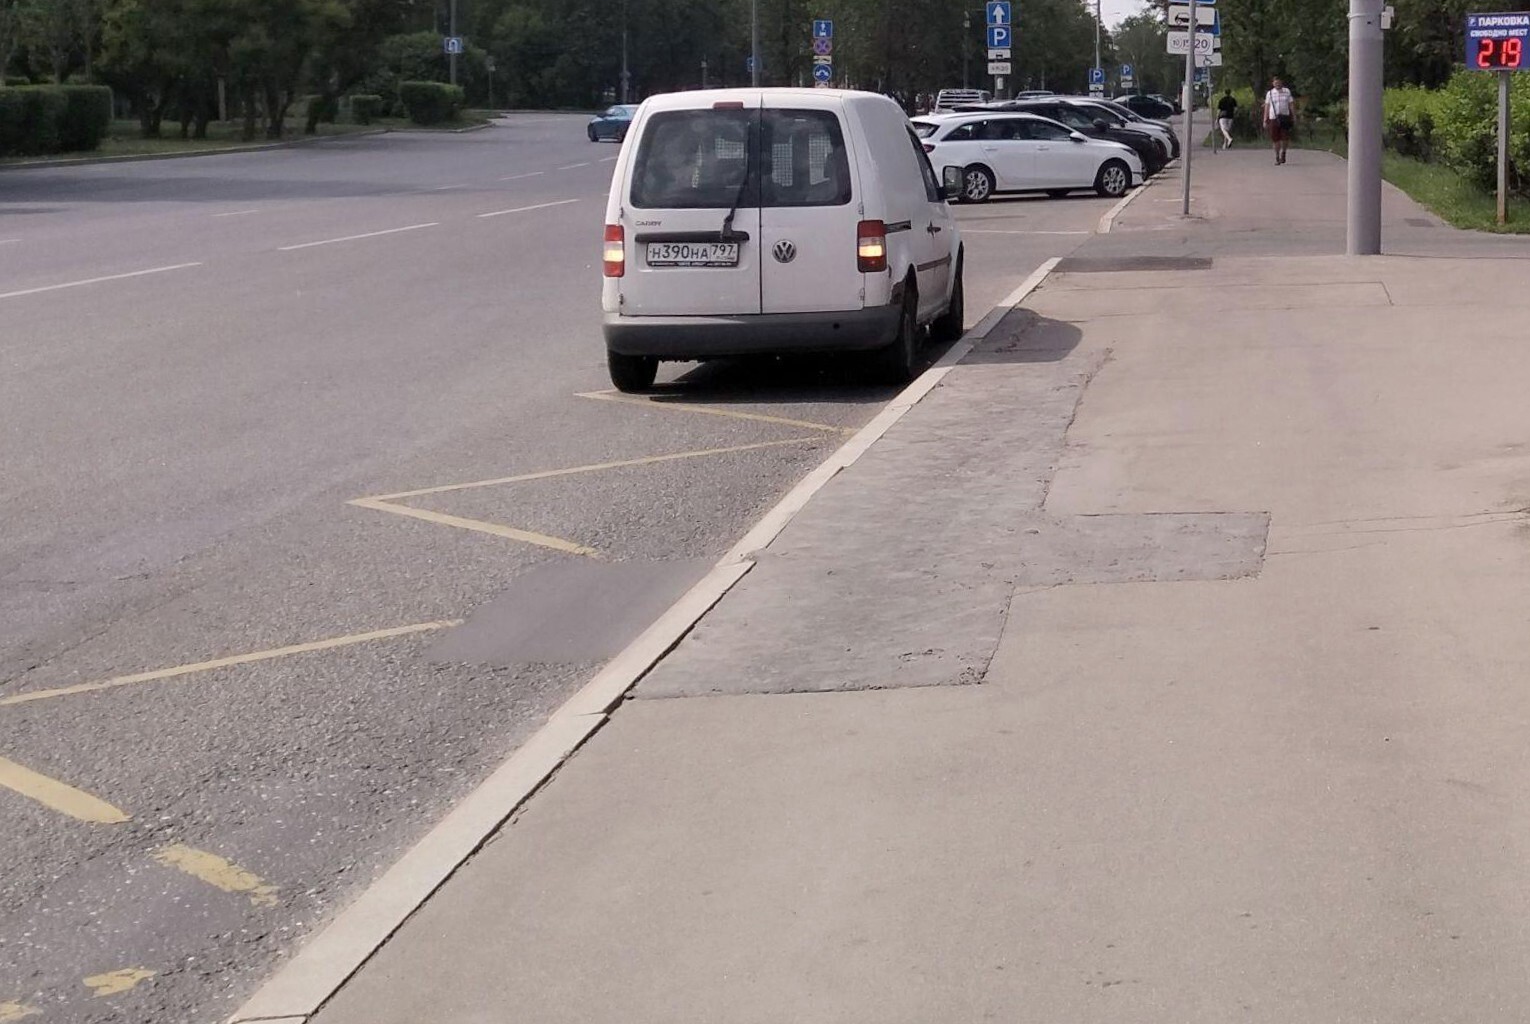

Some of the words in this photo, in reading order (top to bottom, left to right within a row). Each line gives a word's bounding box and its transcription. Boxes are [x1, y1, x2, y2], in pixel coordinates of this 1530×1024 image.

[1478, 16, 1530, 26] ПАРКОВКА
[1509, 28, 1528, 36] МЕСТ
[1195, 39, 1208, 48] 20
[1478, 38, 1521, 67] 219
[711, 244, 734, 255] 797
